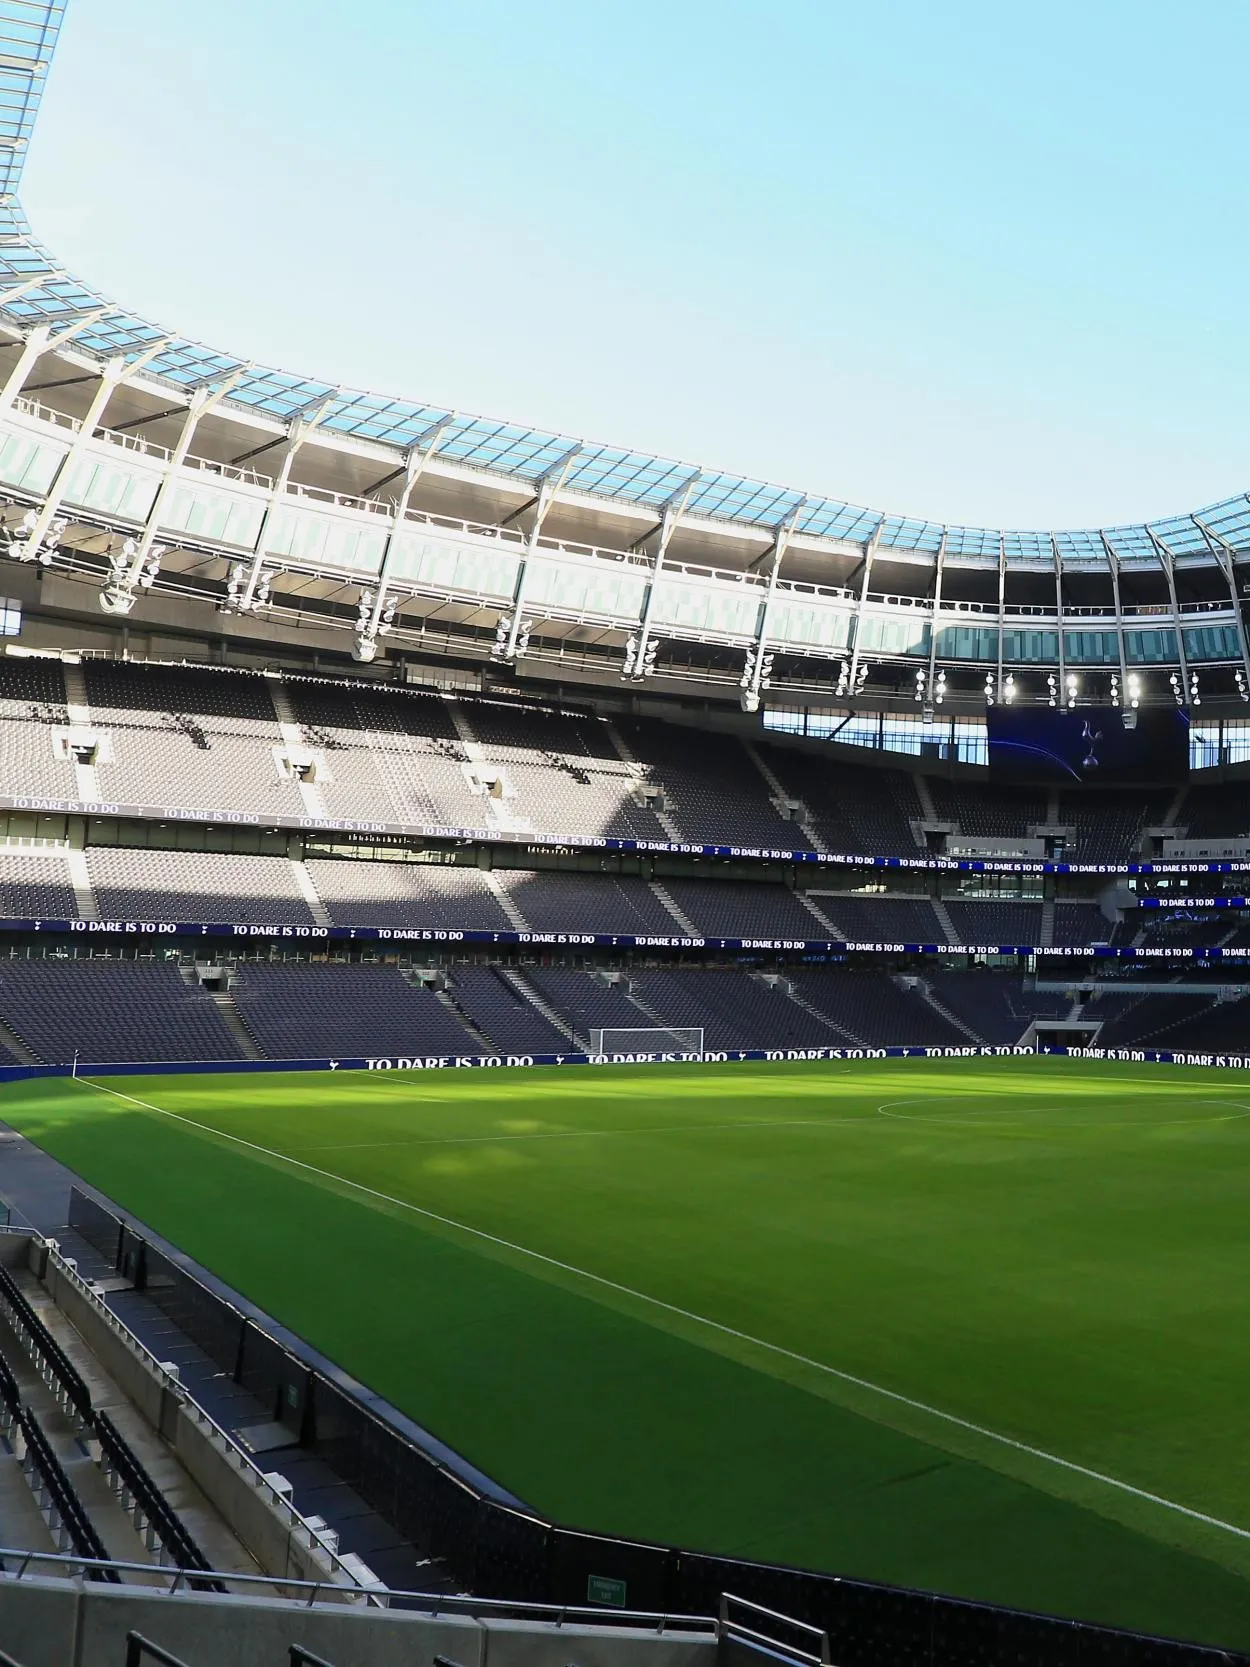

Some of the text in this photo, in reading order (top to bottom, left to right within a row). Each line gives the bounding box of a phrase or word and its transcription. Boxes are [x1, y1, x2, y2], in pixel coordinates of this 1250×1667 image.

[12, 799, 120, 814] TO DARE IS TO DO
[636, 841, 704, 853] TO DARE IS TO DO
[909, 859, 928, 868] DARE
[928, 860, 937, 868] IS
[937, 860, 947, 868] TO
[947, 861, 959, 869] DO
[69, 921, 177, 933] TO DARE IS TO DO
[233, 925, 328, 936] TO DARE IS TO DO
[518, 933, 595, 943] TO DARE IS TO DO
[1135, 948, 1193, 956] TO DARE IS TO DO
[764, 1049, 887, 1060] TO DARE IS TO DO
[924, 1046, 1034, 1057] TO DARE IS TO DO
[1066, 1046, 1145, 1061] TO DARE IS TO DO
[365, 1056, 534, 1069] TO DARE IS TO DO
[585, 1052, 728, 1064] TO DARE IS TO DO
[1171, 1053, 1186, 1064] TO
[1187, 1054, 1214, 1066] DARE
[1216, 1056, 1226, 1067] IS
[1227, 1056, 1242, 1068] TO
